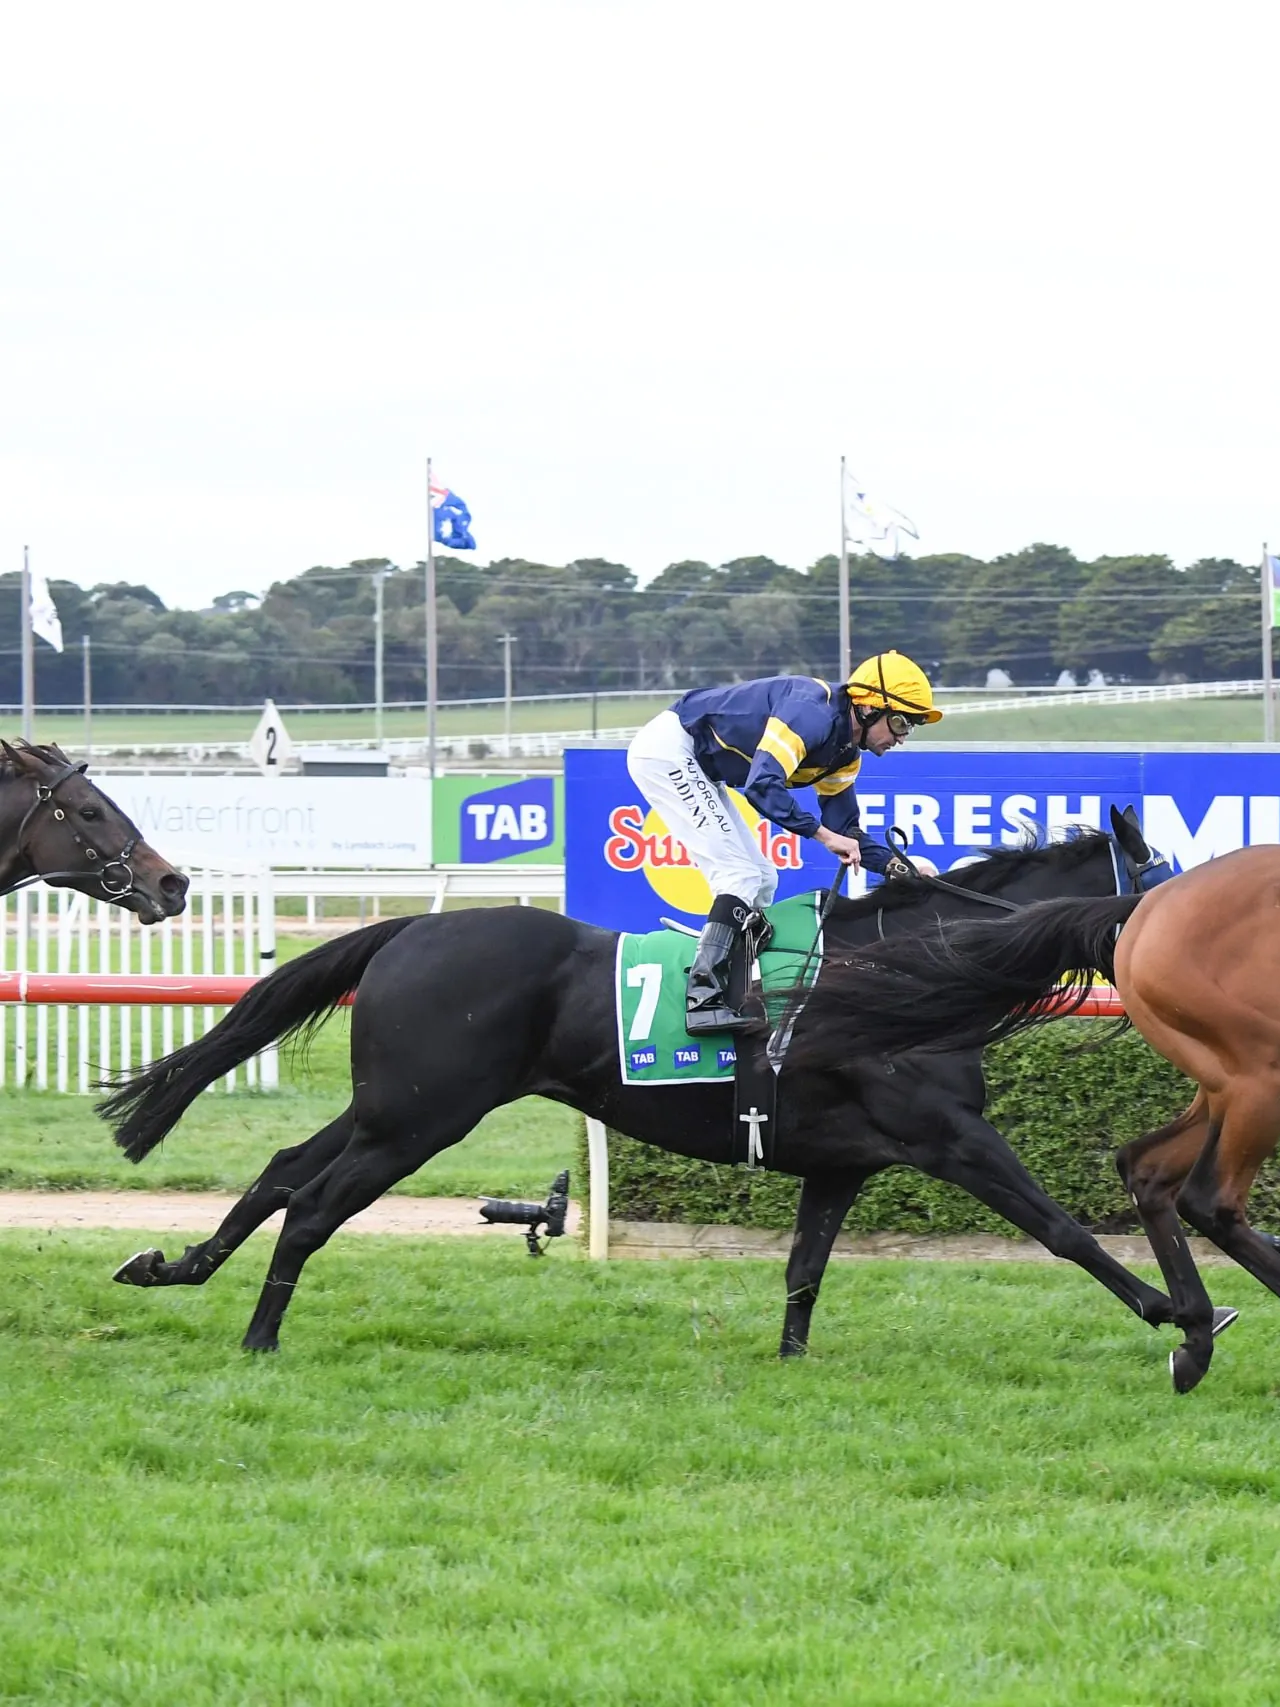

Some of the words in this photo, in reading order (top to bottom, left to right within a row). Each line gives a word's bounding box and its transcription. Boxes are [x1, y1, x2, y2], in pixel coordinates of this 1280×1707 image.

[266, 726, 278, 766] 2
[131, 795, 316, 834] Waterfront
[467, 804, 548, 841] TAB
[855, 794, 1101, 846] FRESH
[626, 963, 662, 1041] 7
[632, 1052, 655, 1065] TAB
[676, 1051, 699, 1062] TAB
[719, 1051, 737, 1062] TA
